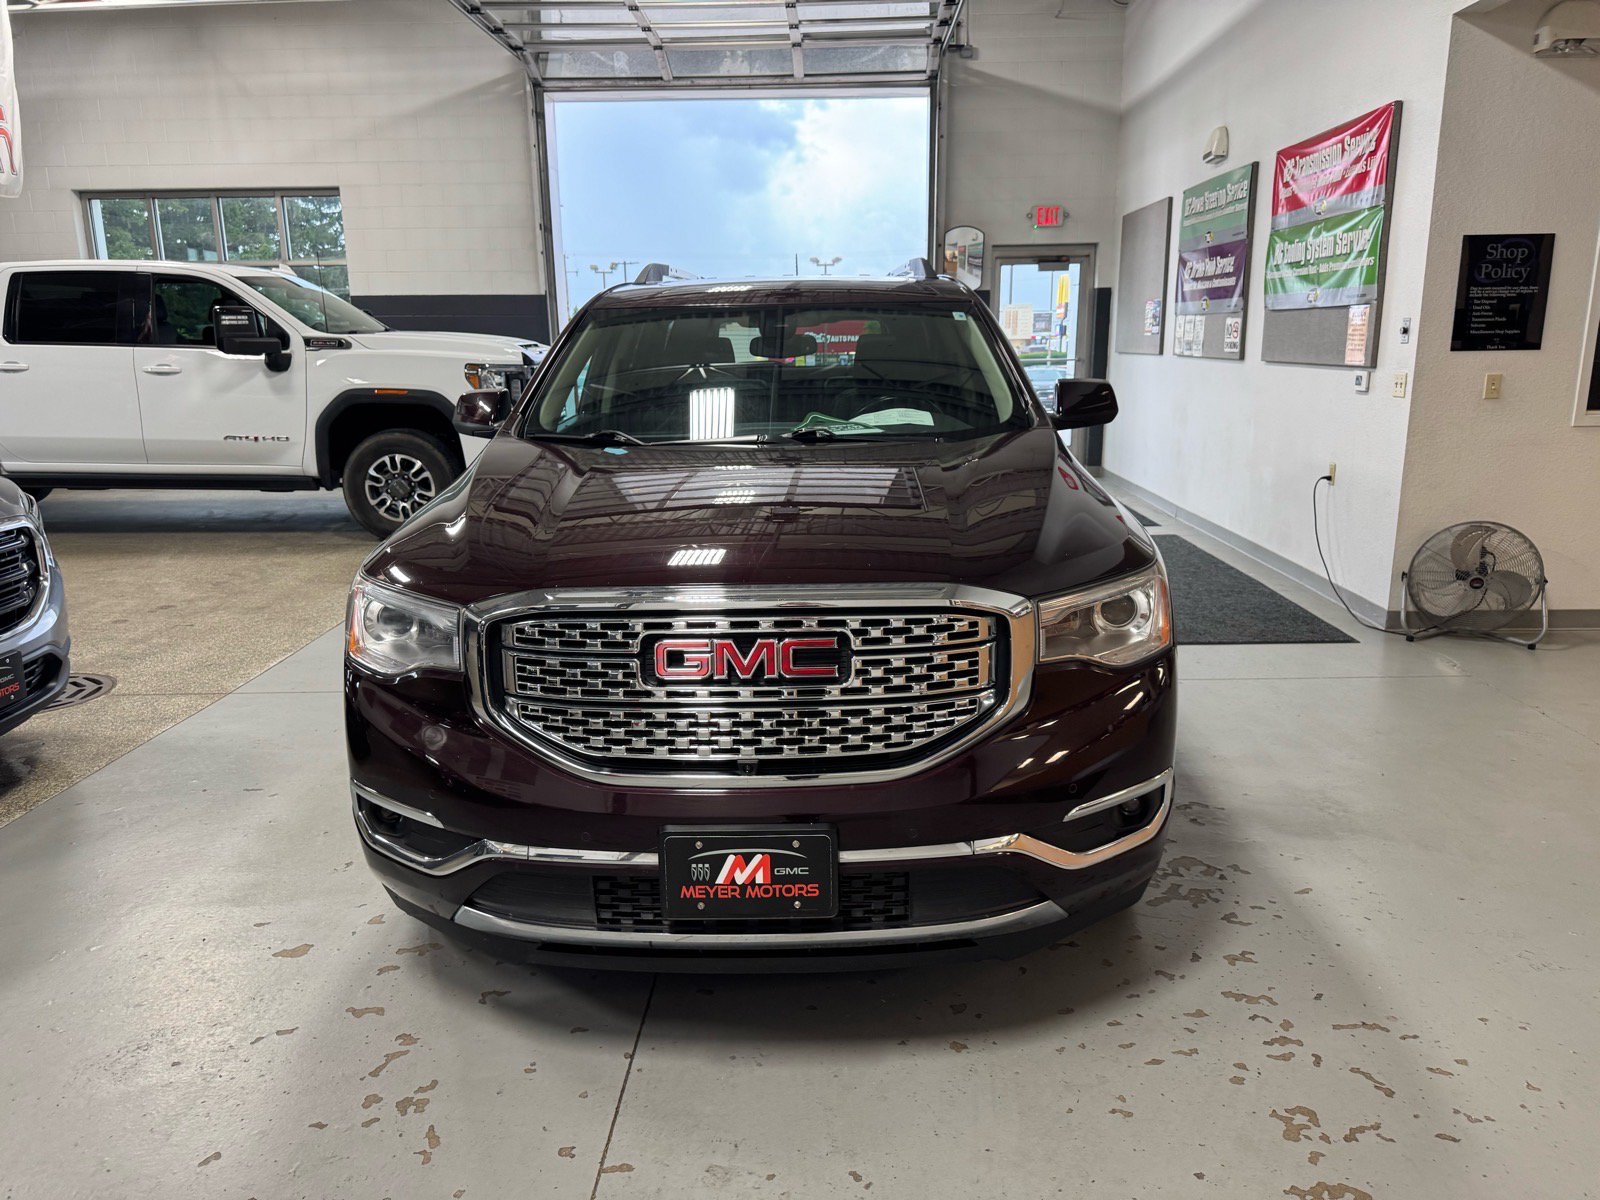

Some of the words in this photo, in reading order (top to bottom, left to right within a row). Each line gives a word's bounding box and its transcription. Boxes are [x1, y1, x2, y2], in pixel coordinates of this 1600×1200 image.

[1295, 143, 1342, 177] Transmission
[1343, 128, 1377, 158] Service
[1205, 187, 1226, 209] Steering
[1226, 179, 1248, 202] Service
[1037, 207, 1059, 225] EXIT
[1306, 236, 1334, 263] System
[1336, 226, 1371, 255] Service
[1486, 243, 1529, 264] Shop
[1215, 253, 1235, 275] Service
[1480, 263, 1531, 283] Policy
[654, 637, 839, 680] GMC
[774, 867, 810, 876] GMC
[680, 885, 741, 899] MEYER
[745, 883, 820, 898] MOTORS
